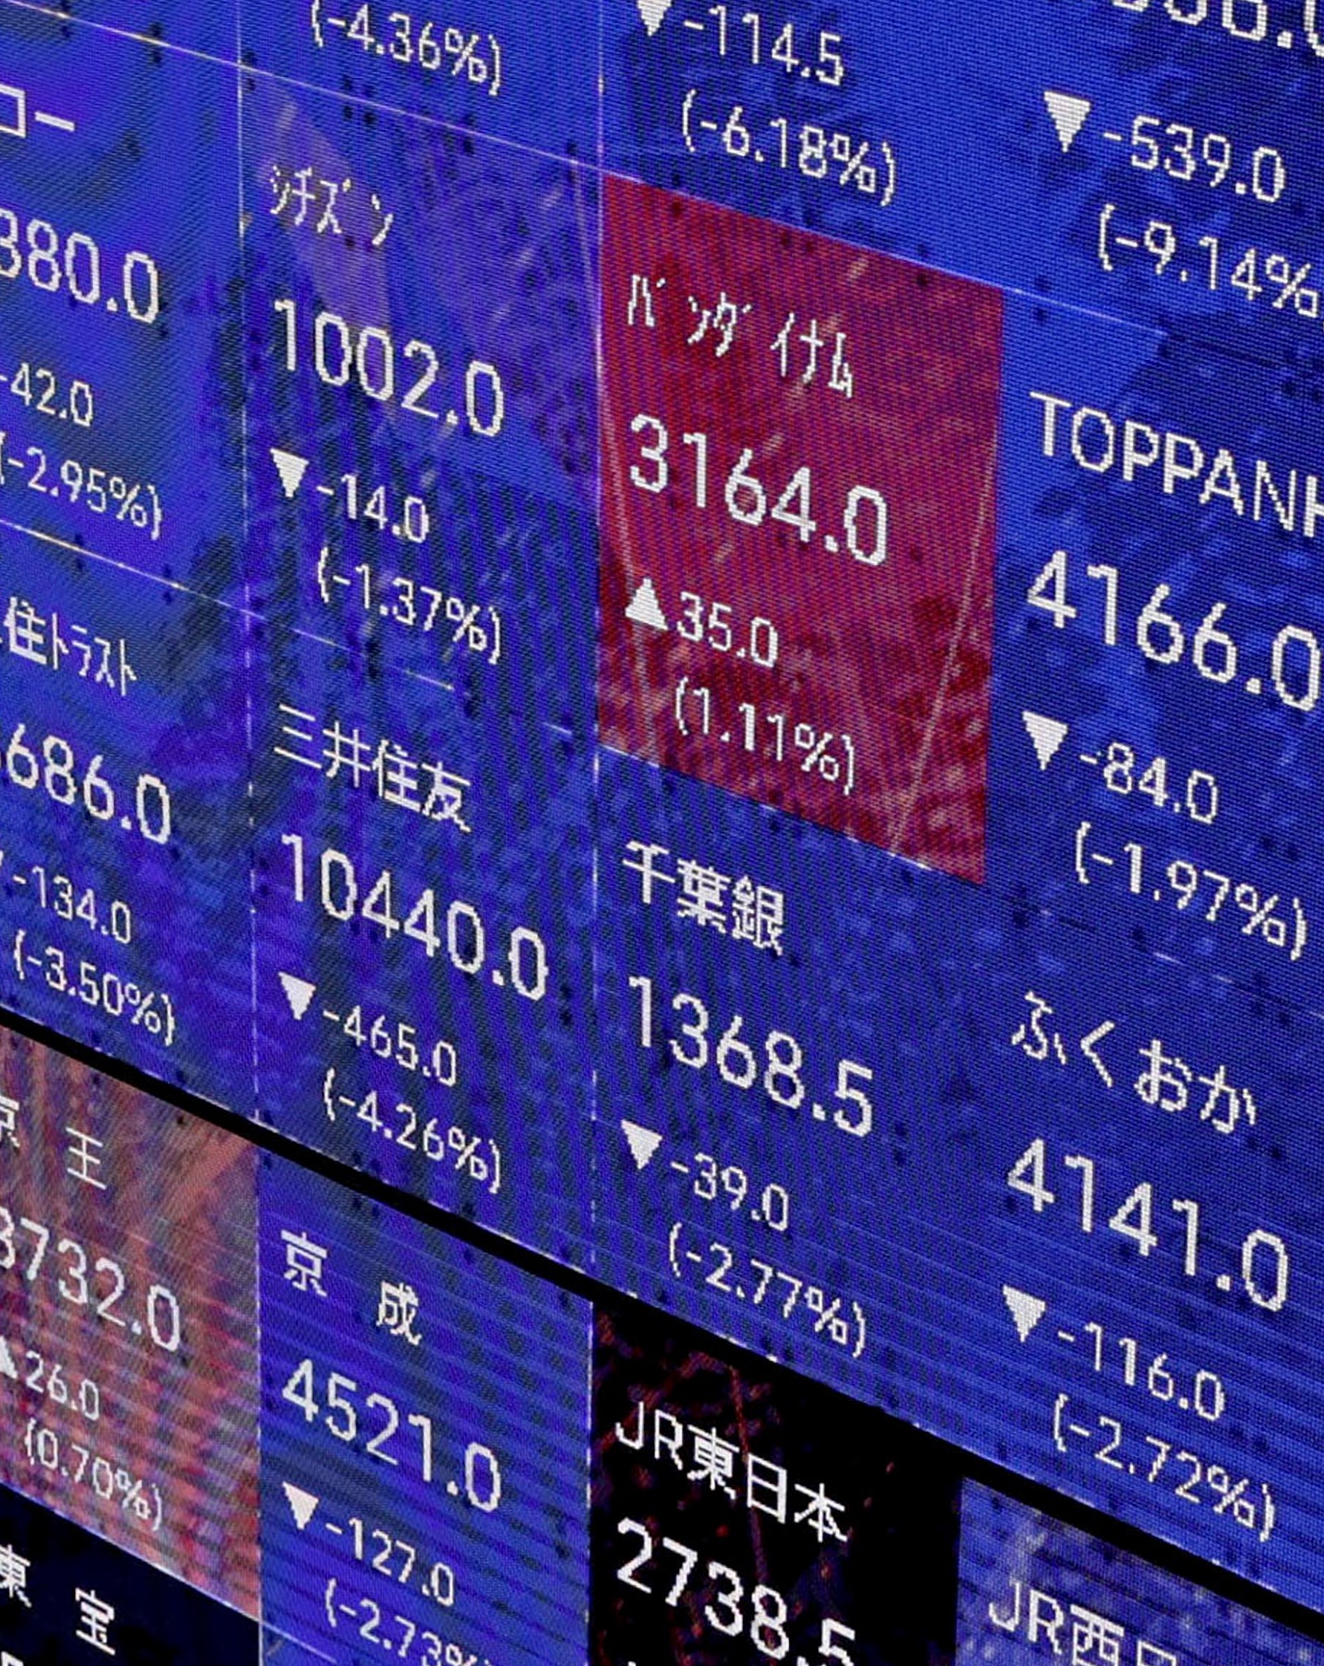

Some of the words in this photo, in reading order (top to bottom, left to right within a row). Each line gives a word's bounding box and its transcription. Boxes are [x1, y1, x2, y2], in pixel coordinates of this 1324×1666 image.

[1102, 114, 1286, 204] -539.0
[316, 474, 431, 544] -14.0
[629, 413, 889, 567] 3164.0
[1026, 549, 1323, 713] 4166.0
[274, 704, 471, 833] 三井住友
[281, 834, 549, 1002] 10440.0
[622, 840, 784, 955] 千葉銀
[1075, 820, 1308, 961] (-1.97%)
[628, 976, 874, 1138] 1368.5
[1010, 990, 1257, 1135] ふくおか
[323, 1068, 502, 1194] (-4.26%)
[282, 1359, 502, 1512] 4521.0
[1058, 1322, 1226, 1422] -116.0
[615, 1402, 849, 1543] JR東日本
[326, 1517, 455, 1607] -127.0
